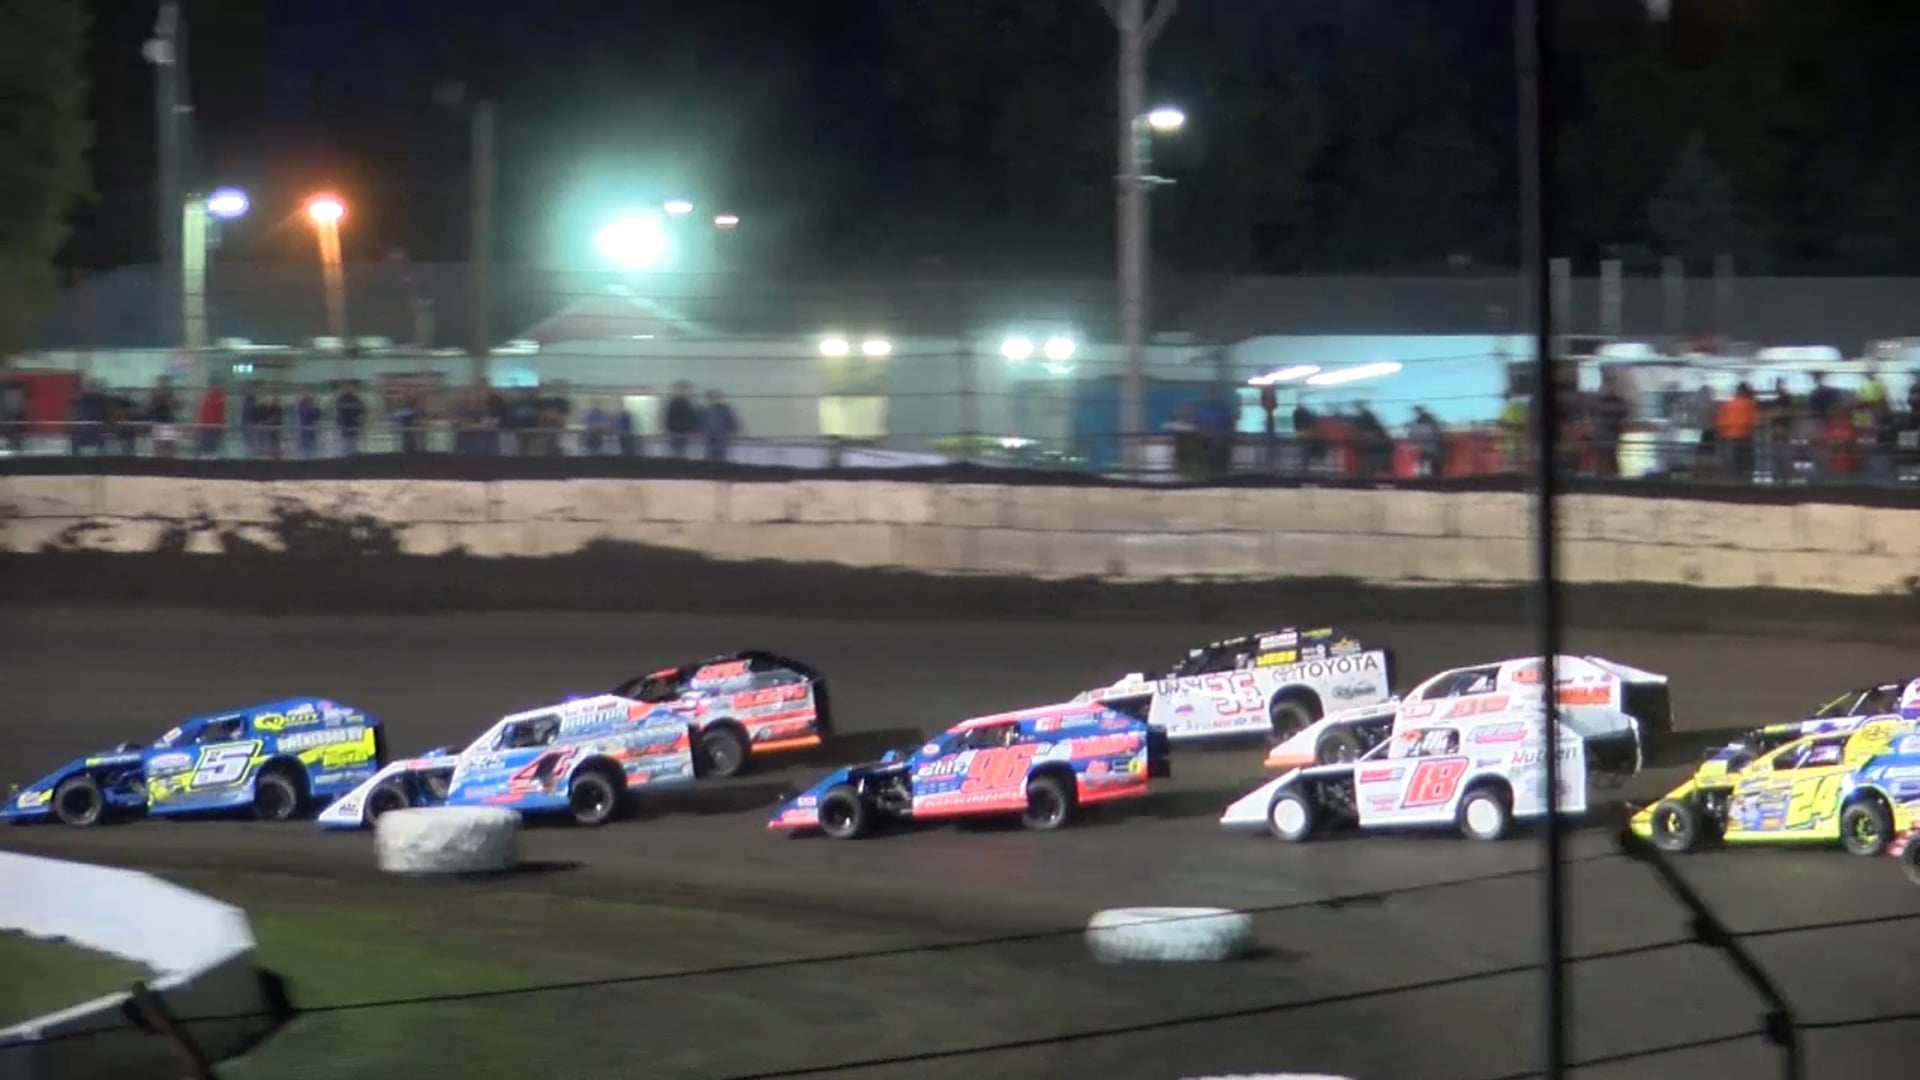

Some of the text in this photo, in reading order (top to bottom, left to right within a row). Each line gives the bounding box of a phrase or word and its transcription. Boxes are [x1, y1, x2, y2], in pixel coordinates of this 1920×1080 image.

[1296, 654, 1378, 679] TOYOTA
[191, 743, 254, 788] 5
[960, 743, 1038, 794] 96
[1511, 747, 1578, 766] Nuten
[1401, 756, 1469, 810] 18
[1785, 771, 1842, 829] 24
